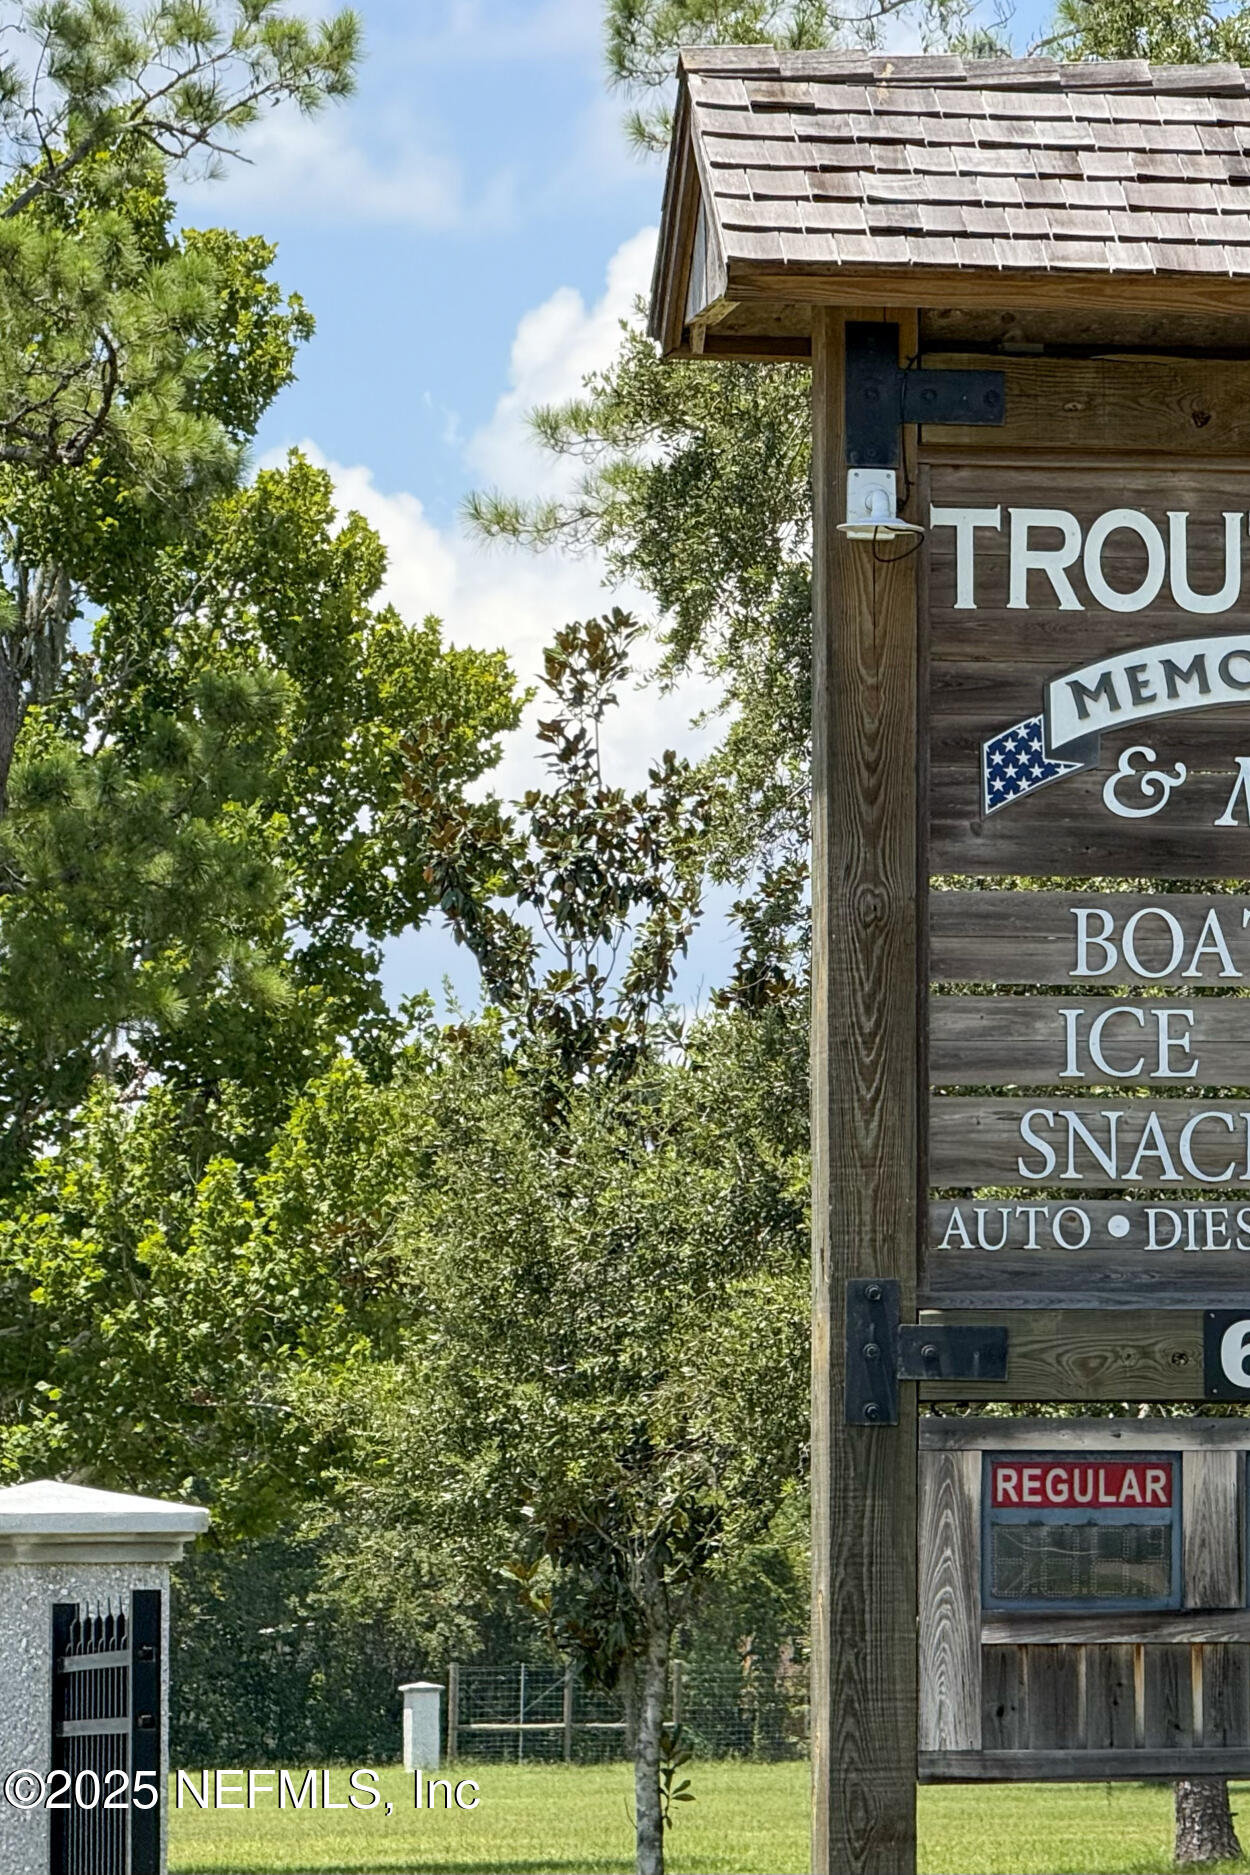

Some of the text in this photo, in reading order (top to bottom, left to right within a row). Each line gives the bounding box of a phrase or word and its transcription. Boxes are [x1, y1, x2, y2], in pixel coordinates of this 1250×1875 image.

[1103, 745, 1187, 820] &
[1058, 1007, 1200, 1080] ICE
[938, 1206, 1091, 1251] AUTO
[995, 1465, 1168, 1504] REGULAR
